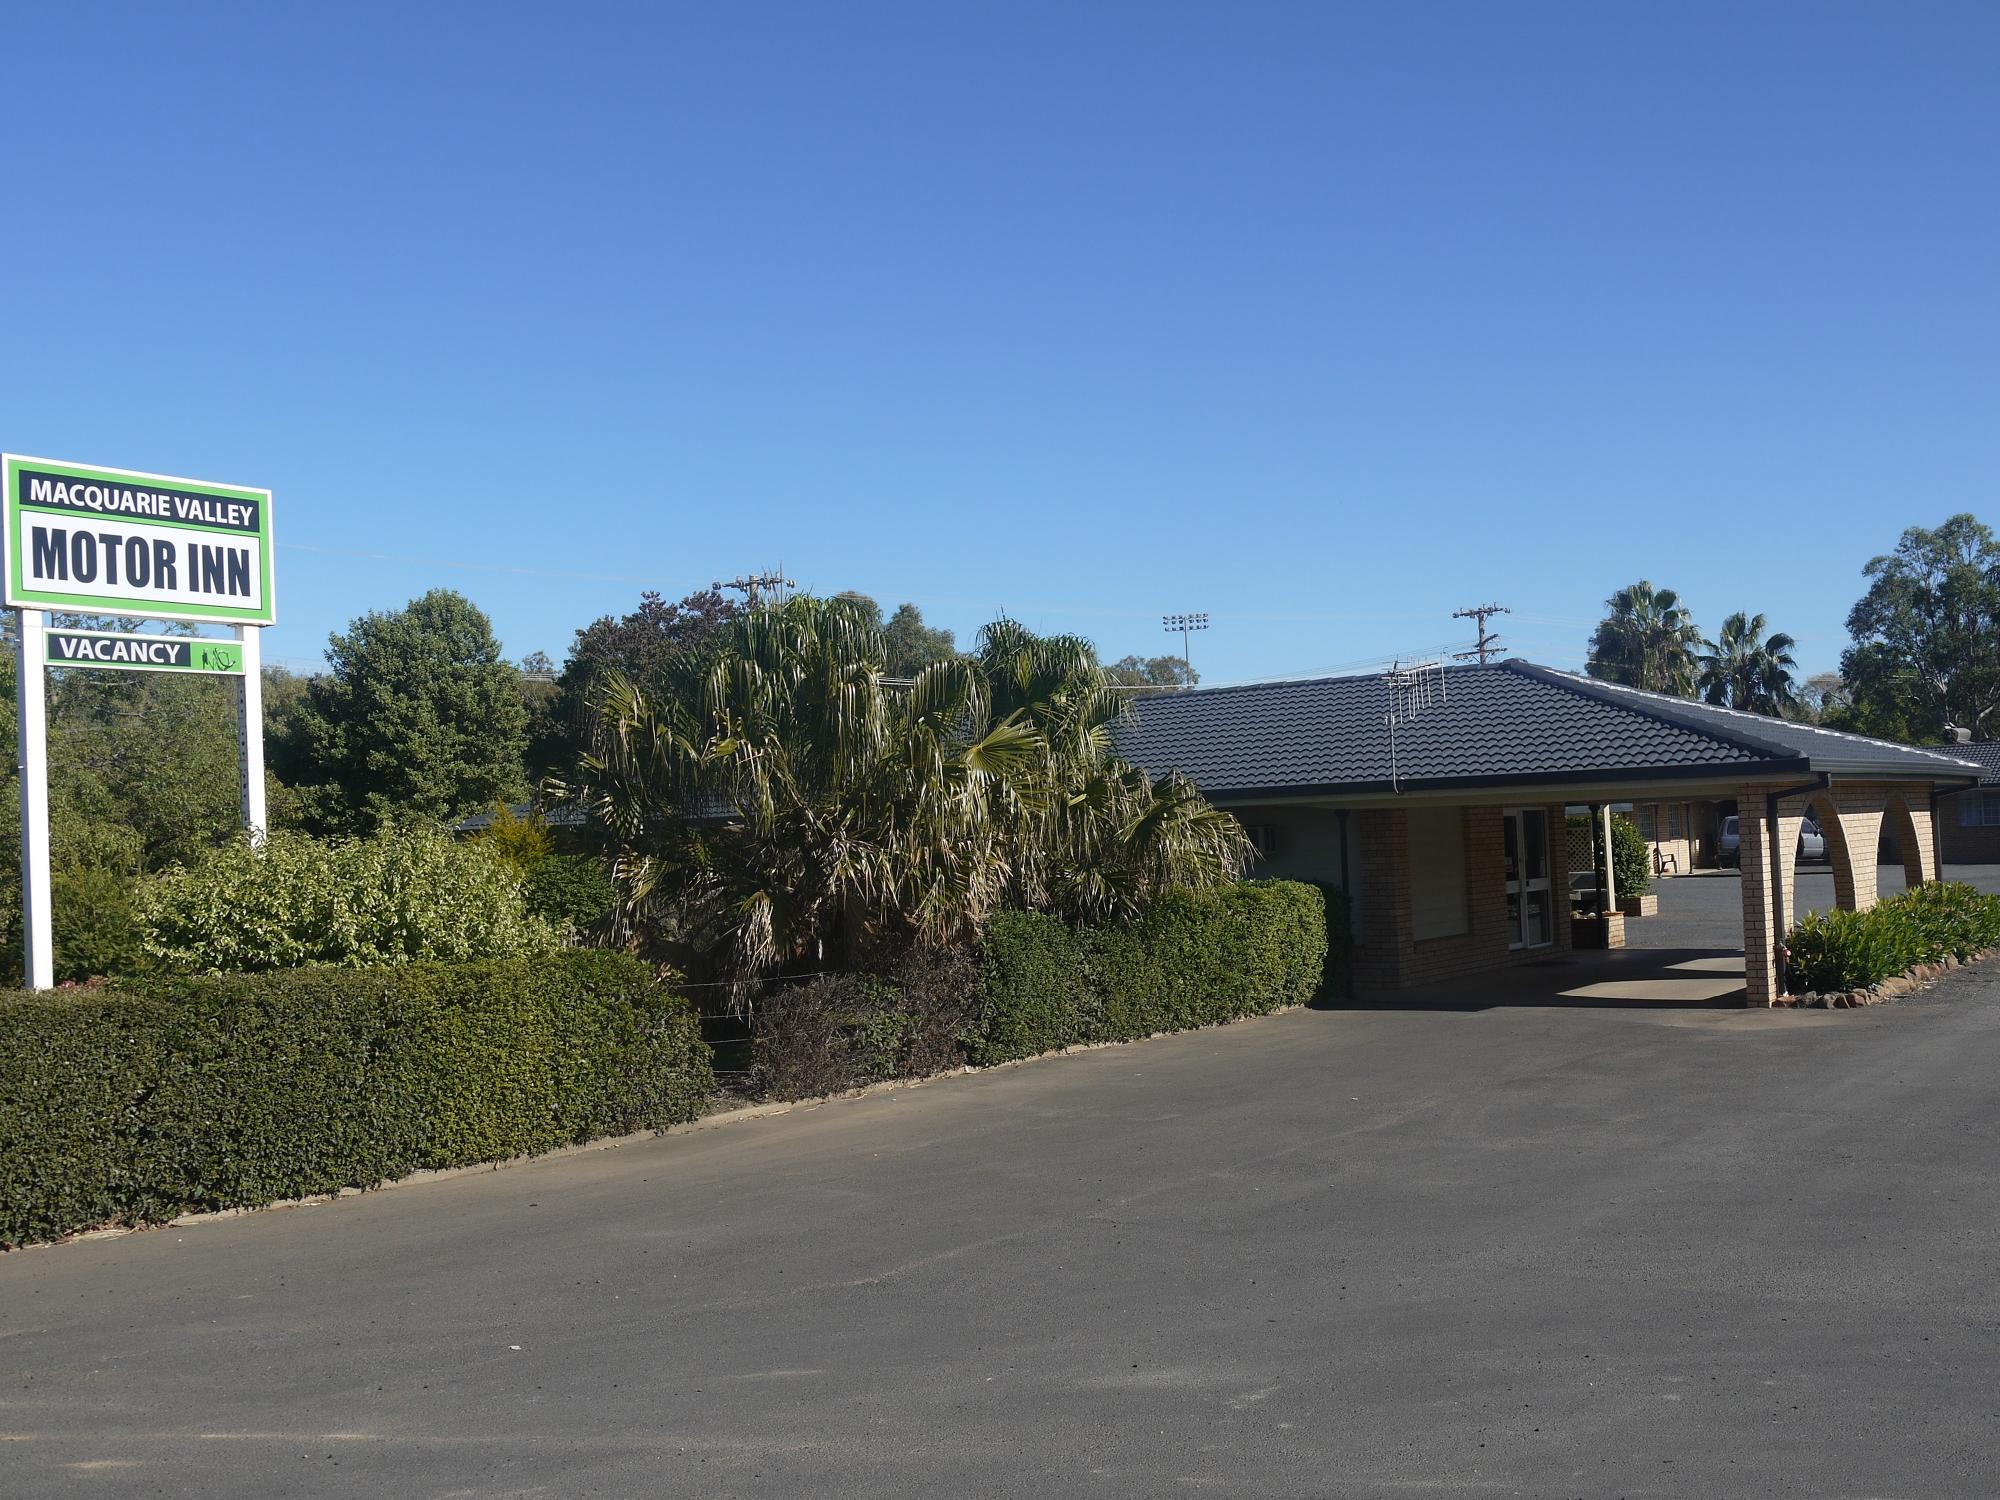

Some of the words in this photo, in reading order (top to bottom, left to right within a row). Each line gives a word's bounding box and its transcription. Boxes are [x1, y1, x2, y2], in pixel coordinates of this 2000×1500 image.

[30, 478, 171, 516] MACQUARIE
[174, 497, 253, 526] VALLEY
[32, 526, 177, 590] MOTOR
[188, 543, 251, 597] INN
[59, 637, 180, 664] VACANCY
